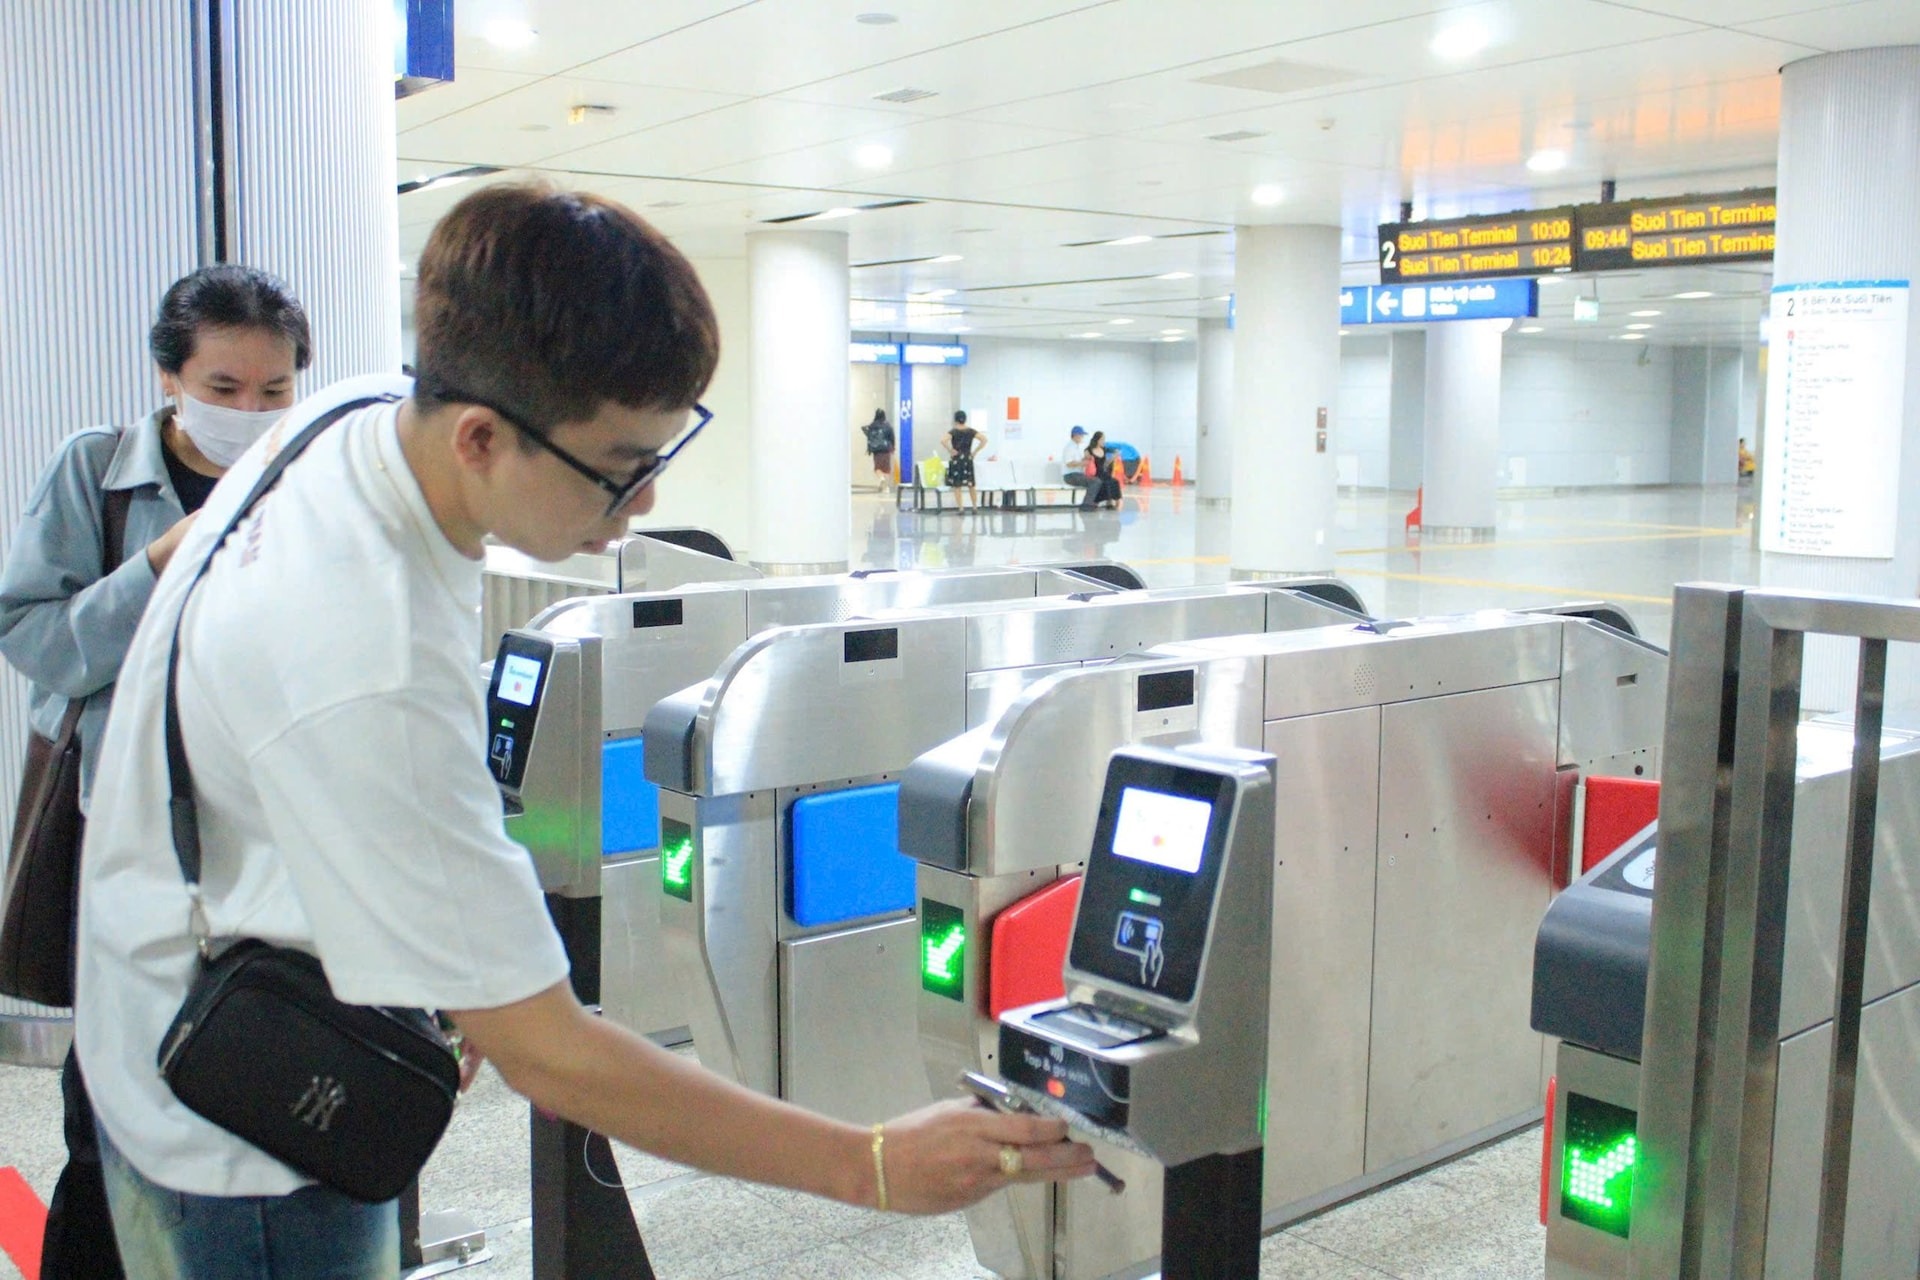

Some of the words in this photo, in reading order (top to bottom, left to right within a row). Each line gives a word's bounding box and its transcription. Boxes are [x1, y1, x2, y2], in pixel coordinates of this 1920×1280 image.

[1631, 211, 1666, 232] Suoi
[1670, 209, 1705, 228] Tien
[1709, 203, 1776, 225] Termina
[1398, 233, 1427, 252] Suoi
[1430, 230, 1458, 249] Tien
[1460, 225, 1517, 246] Terminal
[1531, 220, 1570, 240] 10:00
[1585, 228, 1627, 249] 09:44
[1632, 239, 1667, 260] Suoi
[1671, 237, 1706, 256] Tien
[1709, 232, 1776, 254] Termina
[1382, 241, 1396, 269] 2
[1399, 257, 1428, 276] Suoi
[1430, 255, 1459, 273] Tien
[1461, 250, 1518, 271] Terminal
[1532, 247, 1571, 266] 10:24
[1787, 297, 1795, 317] 2
[1024, 1047, 1041, 1069] Tap
[1042, 1057, 1051, 1072] &
[1052, 1063, 1066, 1078] go
[1068, 1068, 1090, 1087] with
